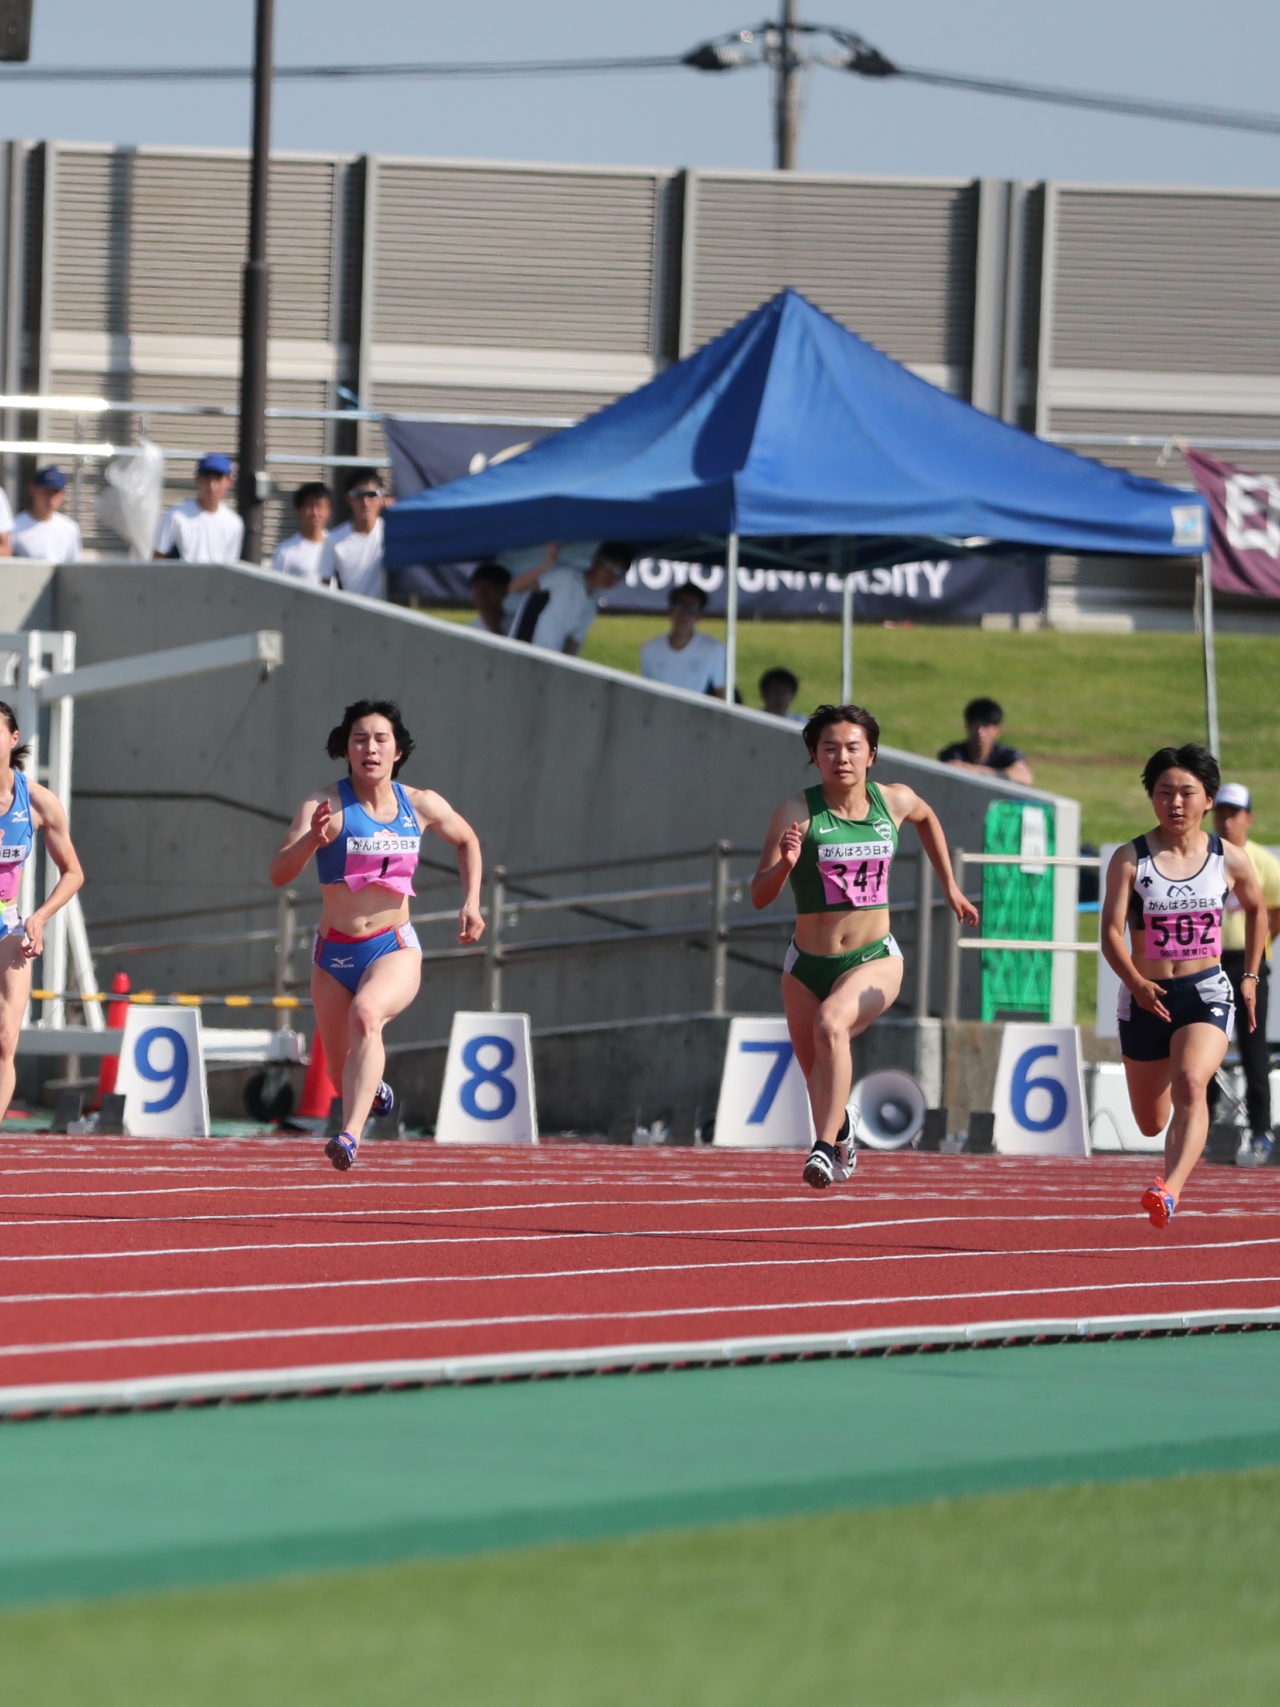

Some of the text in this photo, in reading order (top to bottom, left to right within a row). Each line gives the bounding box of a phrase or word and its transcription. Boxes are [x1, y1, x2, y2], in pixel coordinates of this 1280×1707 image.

[352, 839, 417, 851] がんばろう日本
[825, 845, 889, 857] がんばろう日本
[1148, 898, 1217, 910] がんばろう日本
[1151, 913, 1215, 947] 502
[134, 1026, 189, 1113] 9
[460, 1035, 516, 1120] 8
[740, 1041, 794, 1125] 7
[1010, 1045, 1068, 1132] 6
